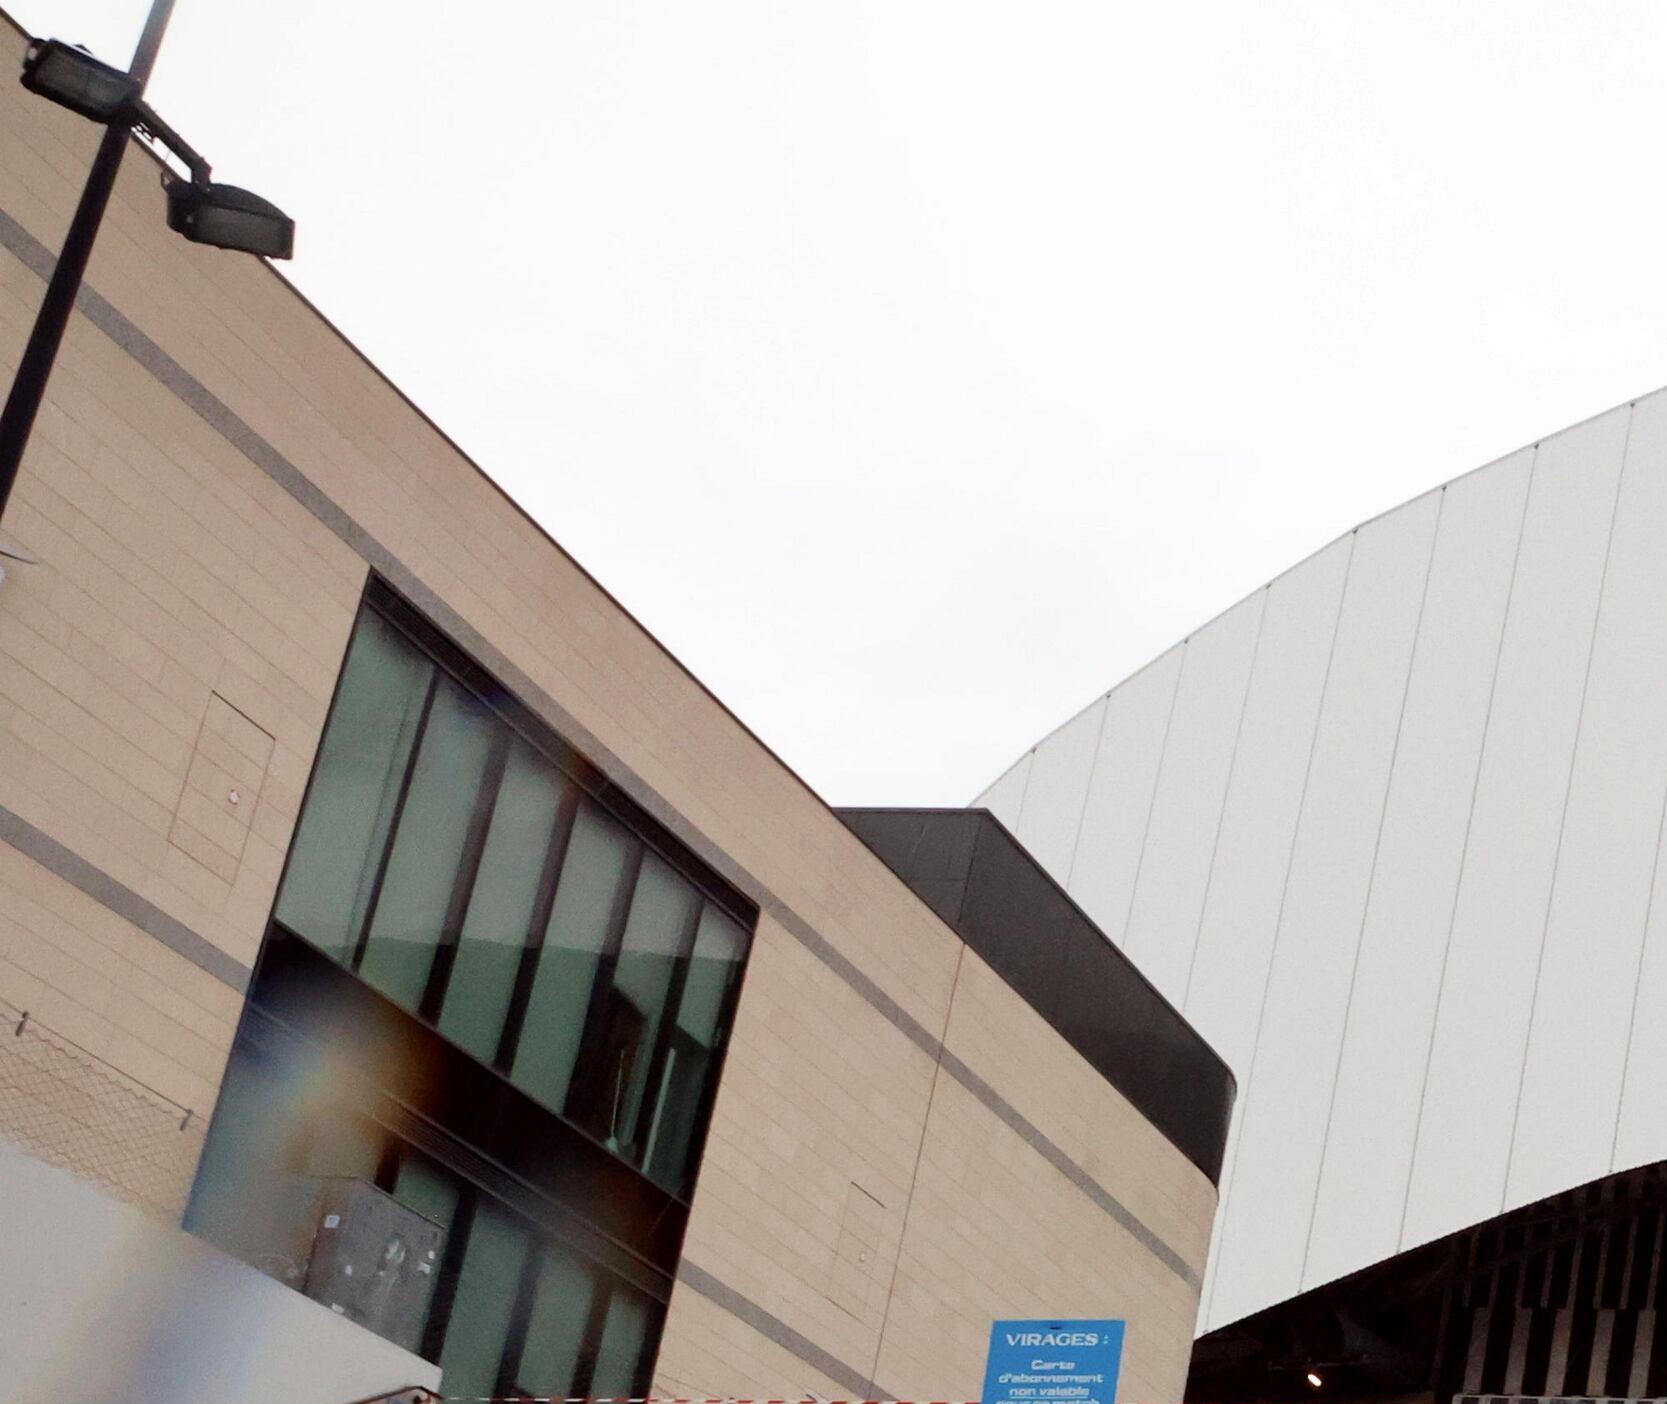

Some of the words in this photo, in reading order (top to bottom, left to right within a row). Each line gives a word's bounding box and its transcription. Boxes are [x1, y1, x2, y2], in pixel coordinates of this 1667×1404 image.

[1005, 1332, 1099, 1346] VIRAGES
[1031, 1359, 1076, 1370] Carte
[998, 1373, 1104, 1384] d'abonnement
[1008, 1386, 1037, 1396] non
[1038, 1385, 1090, 1397] valable
